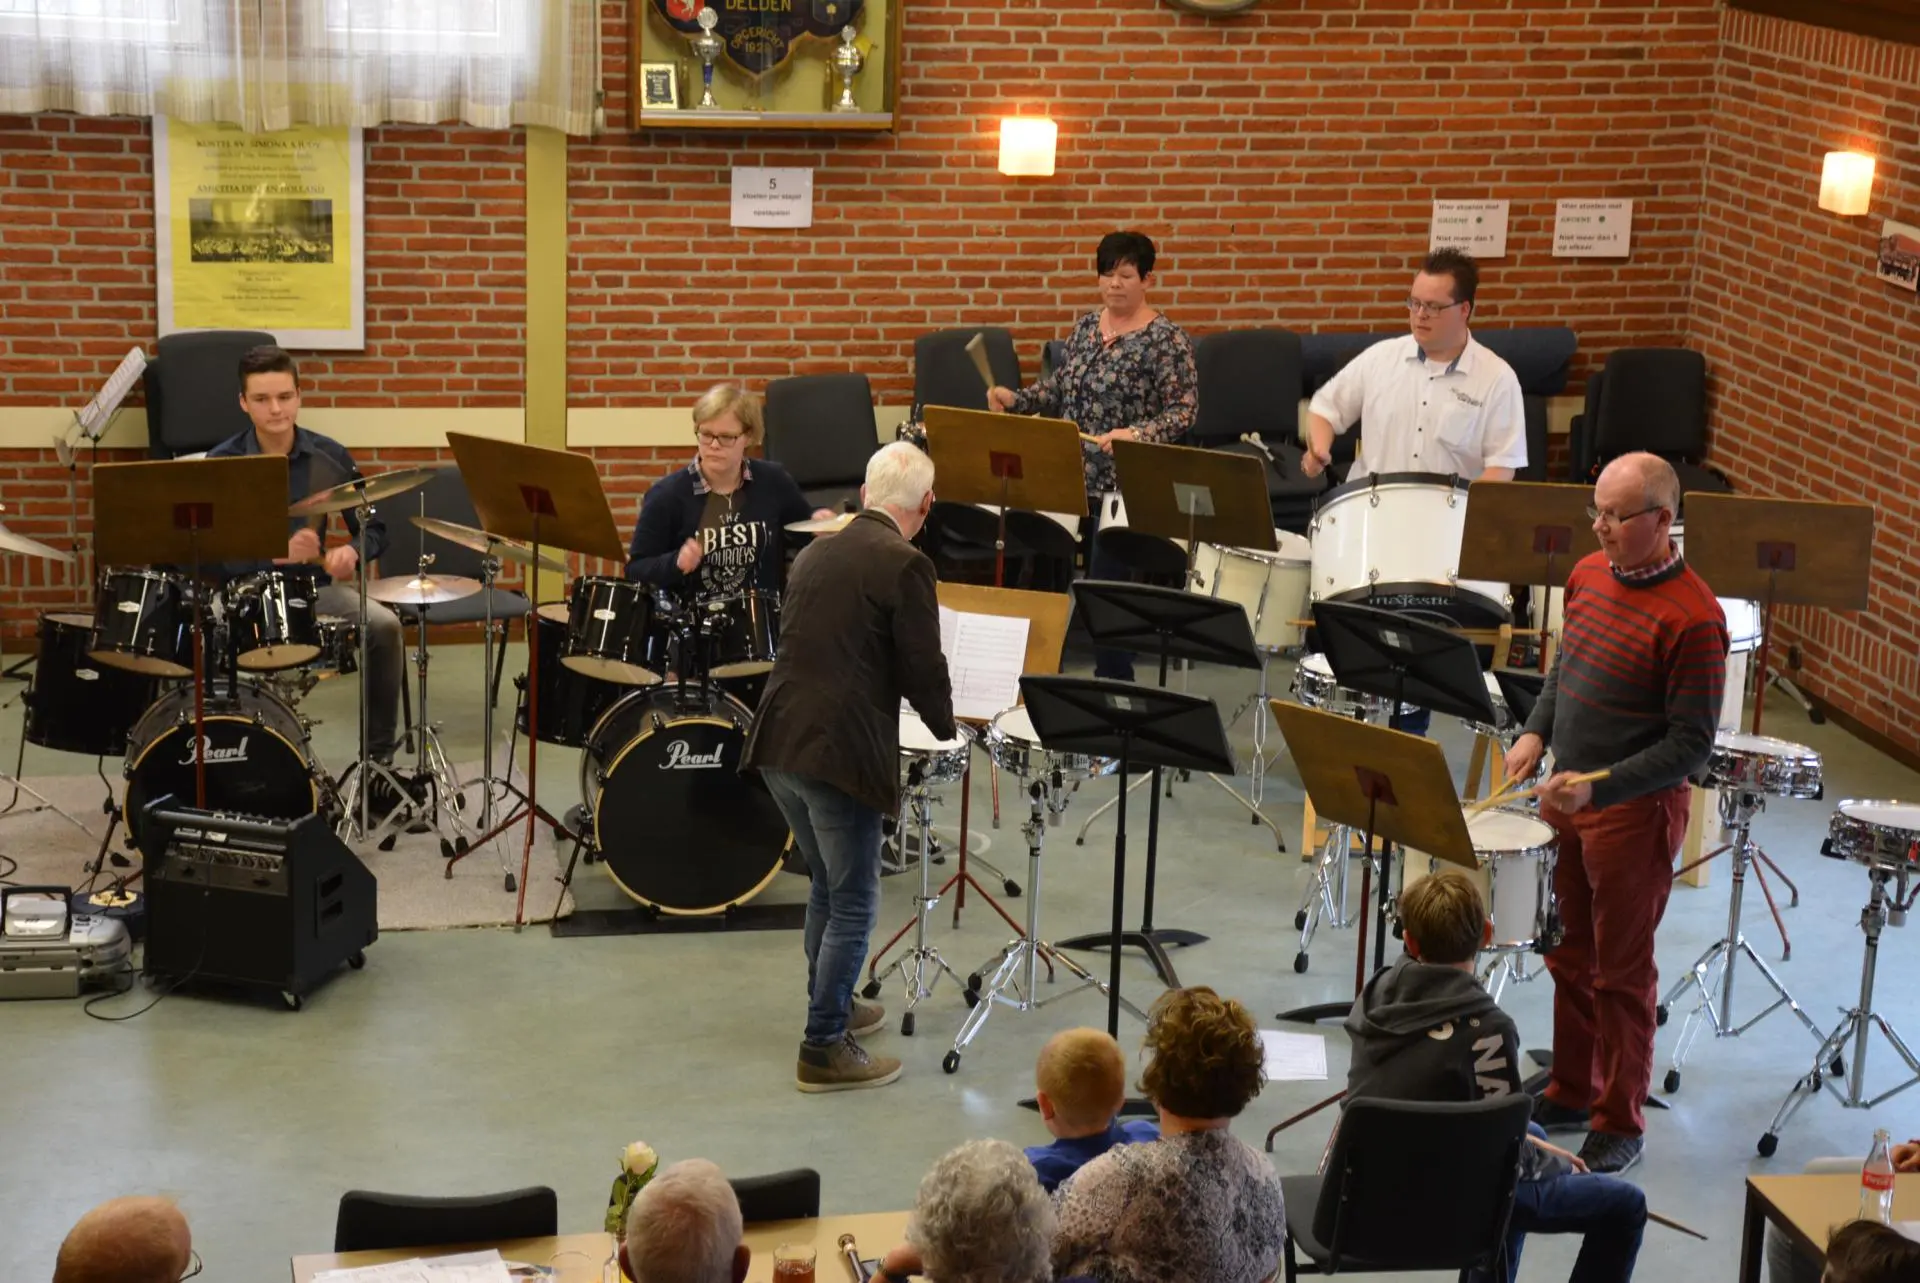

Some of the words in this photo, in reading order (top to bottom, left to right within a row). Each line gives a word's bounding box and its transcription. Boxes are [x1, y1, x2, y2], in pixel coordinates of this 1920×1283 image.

[769, 178, 777, 190] 5
[719, 512, 741, 525] THE
[703, 521, 760, 556] BEST
[703, 547, 756, 567] JOURNEYS
[178, 735, 249, 766] Pearl
[658, 739, 725, 770] Pearl
